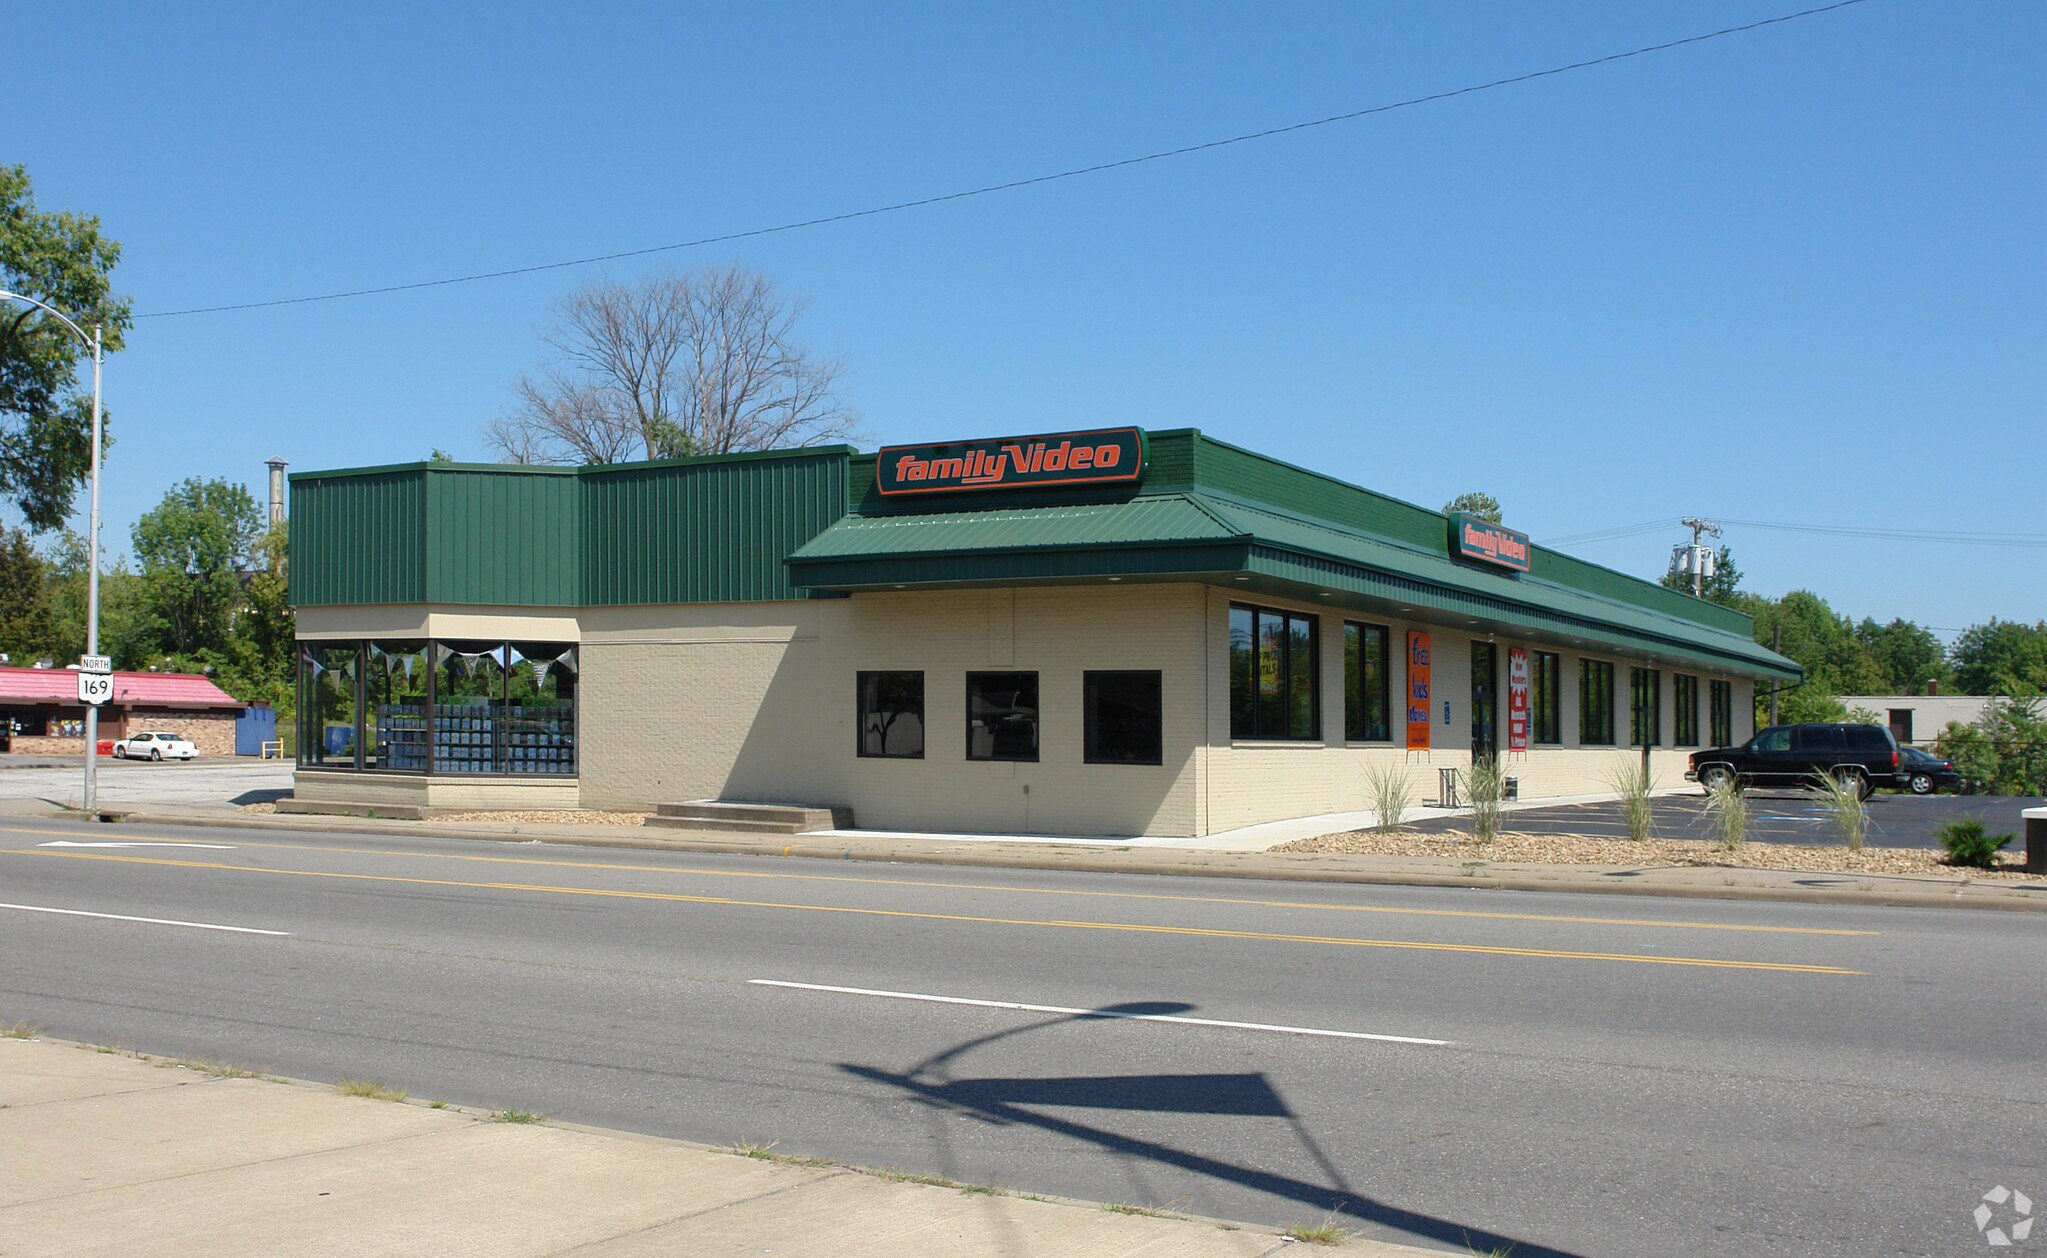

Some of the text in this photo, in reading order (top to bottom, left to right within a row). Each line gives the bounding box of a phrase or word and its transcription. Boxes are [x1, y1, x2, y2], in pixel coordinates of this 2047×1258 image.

[83, 658, 109, 669] NORTH
[84, 680, 108, 695] 169
[1412, 671, 1428, 699] kids
